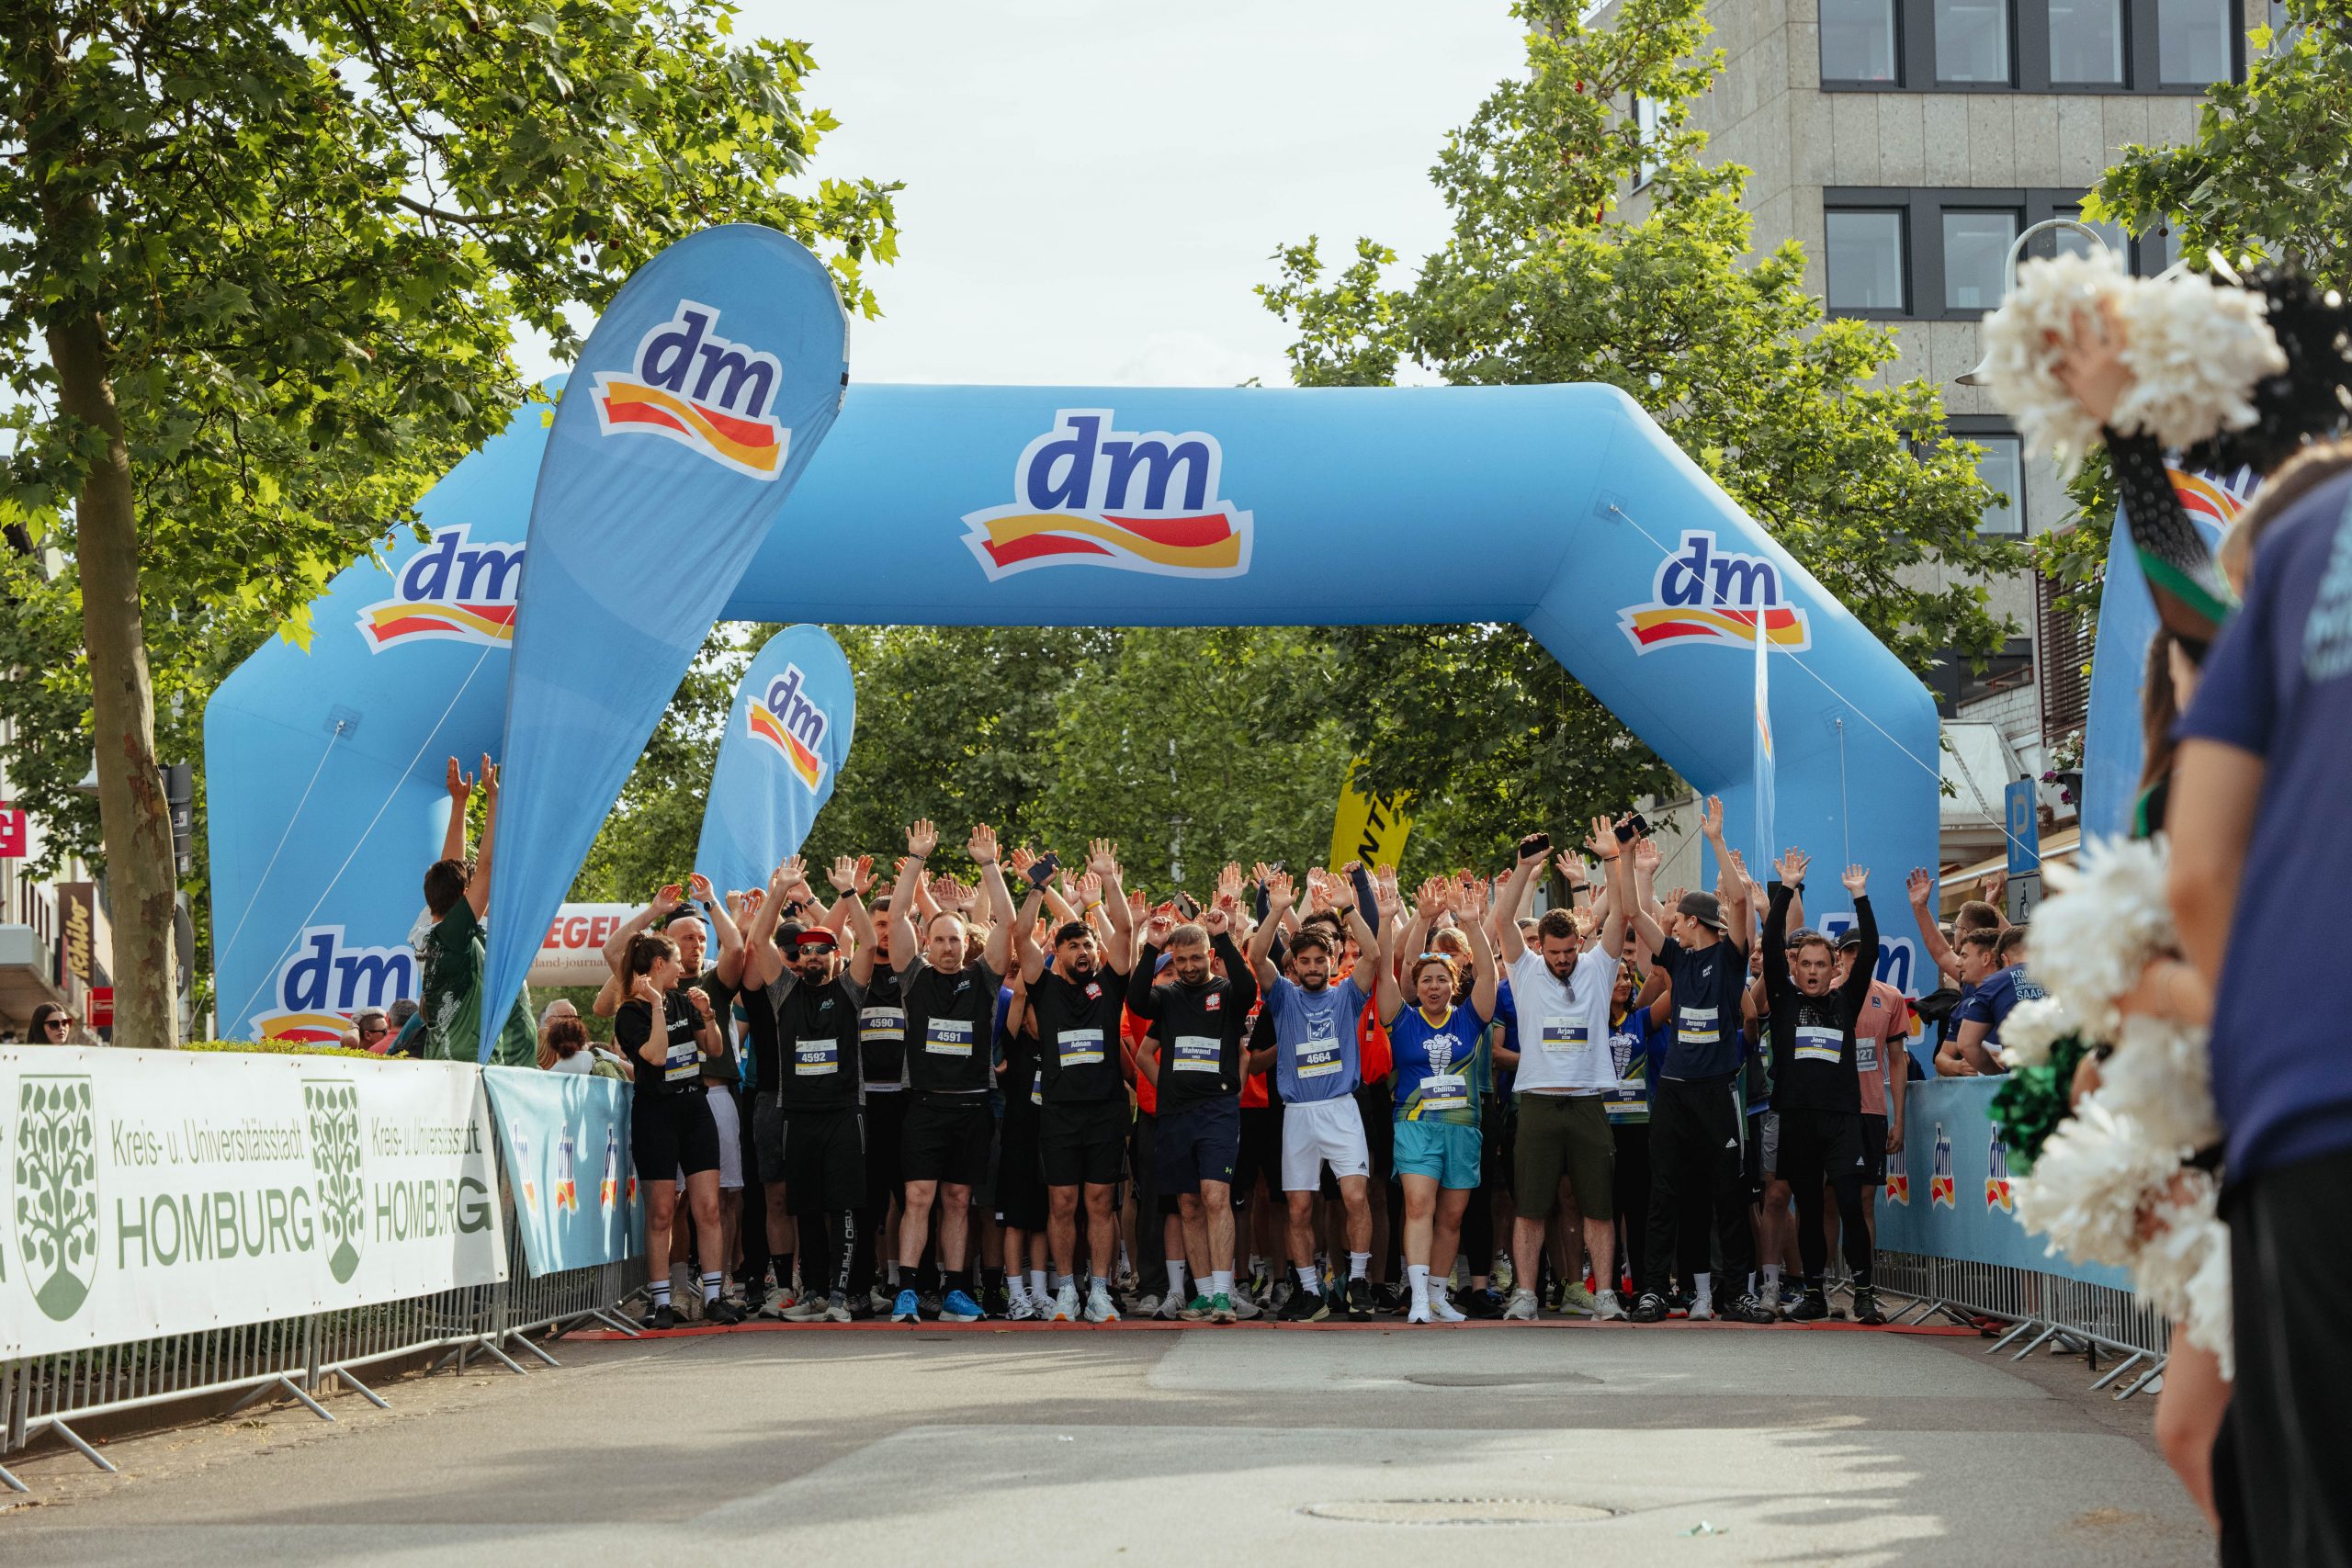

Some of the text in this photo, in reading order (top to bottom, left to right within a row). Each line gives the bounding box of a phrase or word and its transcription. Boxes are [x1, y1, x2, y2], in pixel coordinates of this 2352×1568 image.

[641, 310, 774, 419] dm
[1027, 416, 1210, 511] dm
[402, 531, 526, 602] dm
[1661, 537, 1776, 606] dm
[768, 671, 824, 751] dm
[2013, 794, 2030, 862] P
[284, 933, 412, 1012] dm
[870, 1018, 894, 1028] 4590
[937, 1032, 961, 1043] 4591
[1070, 1040, 1091, 1048] Adnan
[1686, 1020, 1707, 1028] Jeremy
[801, 1052, 827, 1063] 4592
[1306, 1052, 1331, 1065] 4664
[111, 1117, 304, 1167] Kreis- u. Universitätsstadt
[371, 1116, 401, 1156] Kreis-
[559, 1126, 573, 1179] dm
[1935, 1127, 1951, 1176] dm
[1989, 1126, 2007, 1178] dm
[117, 1186, 315, 1269] HOMBURG
[375, 1176, 493, 1243] HOMBURG
